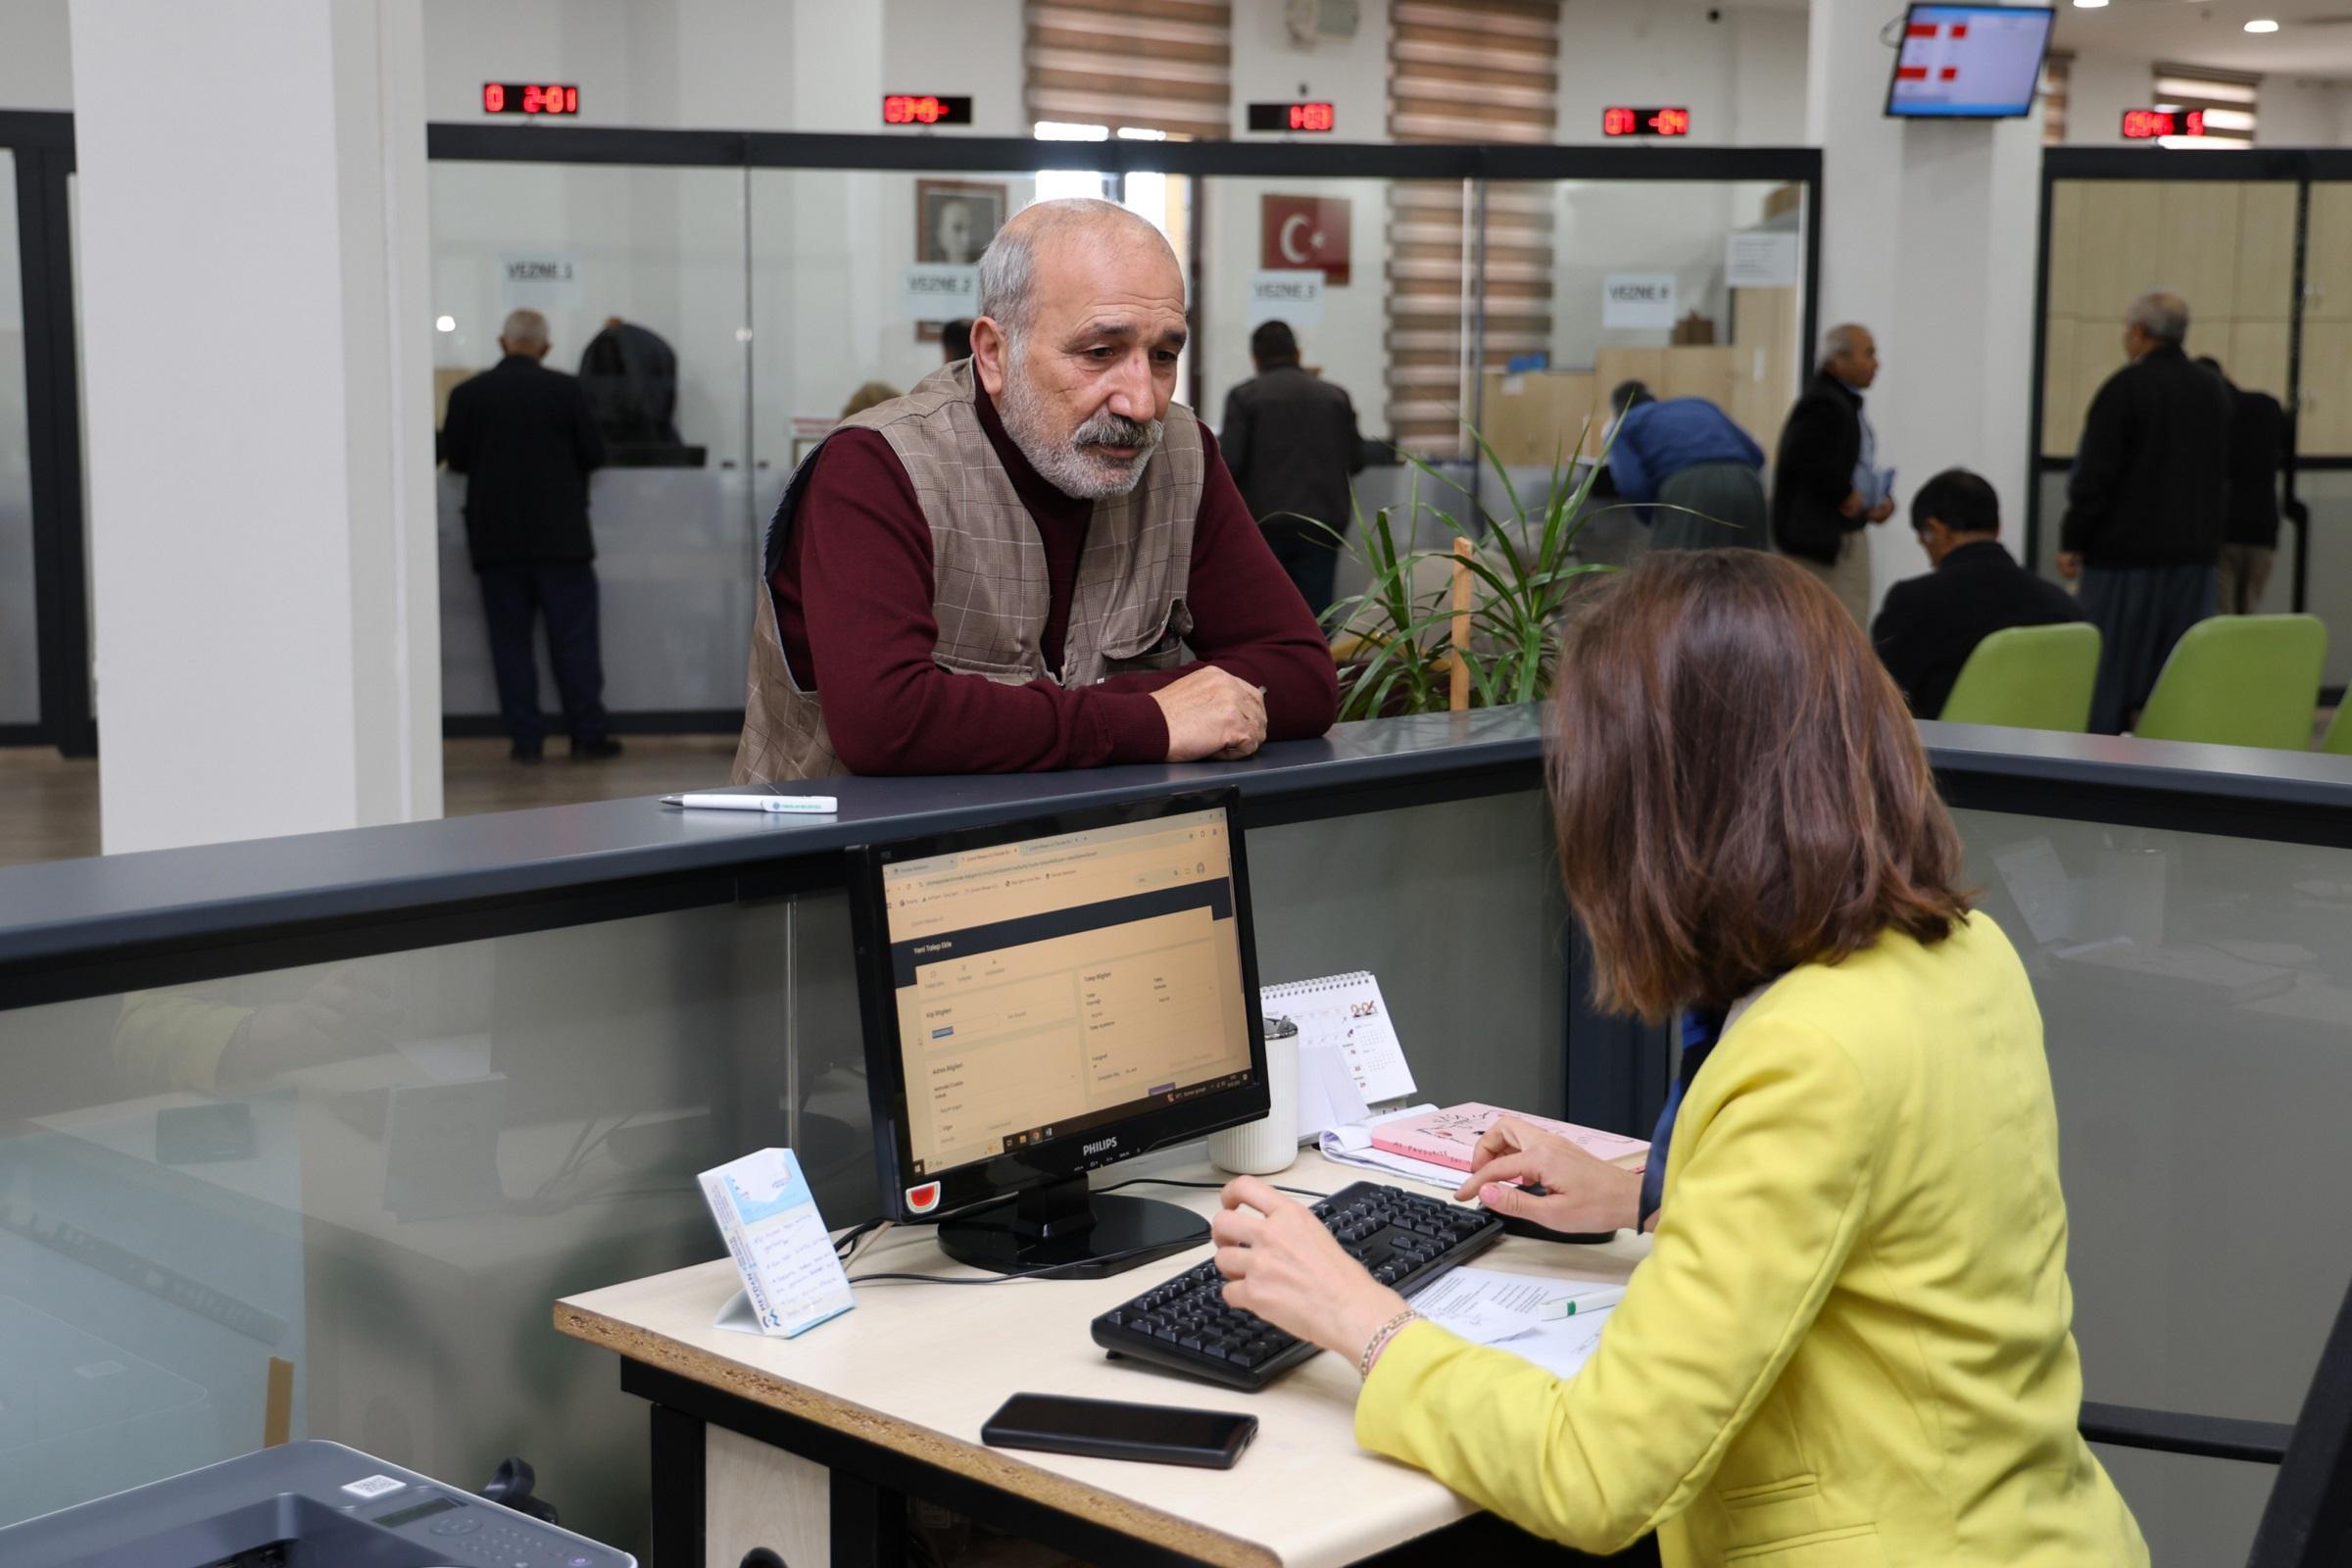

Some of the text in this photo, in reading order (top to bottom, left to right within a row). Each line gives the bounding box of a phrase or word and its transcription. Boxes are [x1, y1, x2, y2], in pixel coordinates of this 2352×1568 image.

[507, 261, 558, 279] VEZNE
[907, 275, 956, 293] VEZNE
[1253, 282, 1302, 299] VEZNE
[1608, 284, 1656, 302] VEZNE
[1083, 1136, 1117, 1156] PHILIPS
